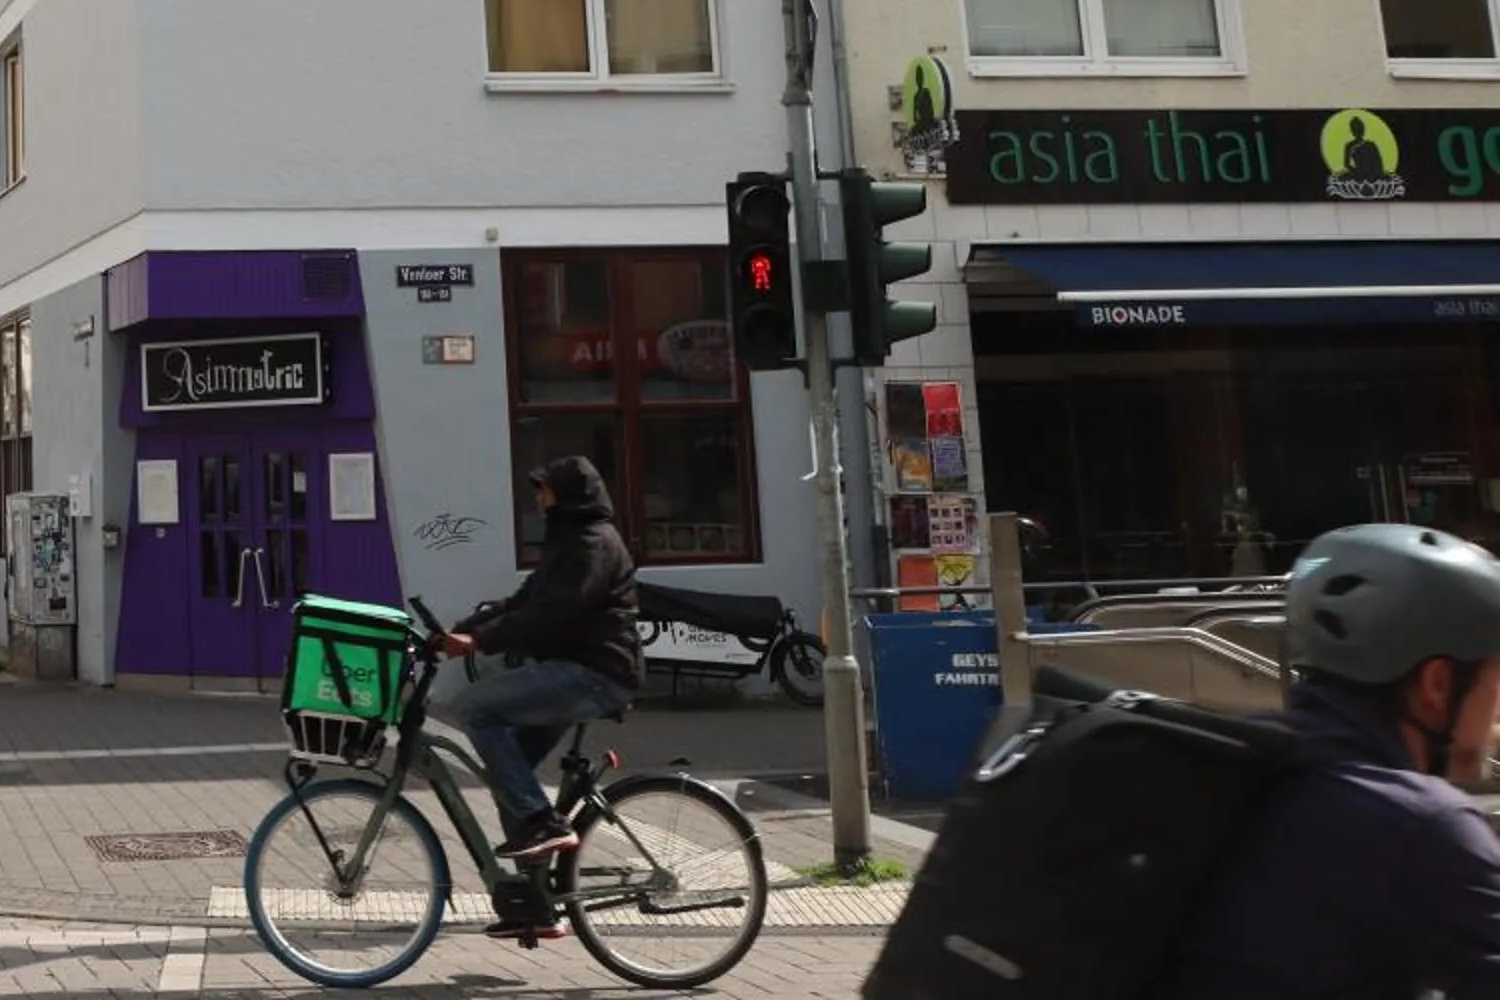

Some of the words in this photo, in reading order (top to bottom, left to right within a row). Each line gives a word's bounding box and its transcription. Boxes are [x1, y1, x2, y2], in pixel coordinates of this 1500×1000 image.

[989, 115, 1119, 184] asia
[1144, 110, 1270, 184] thai
[1091, 304, 1186, 324] BIONADE
